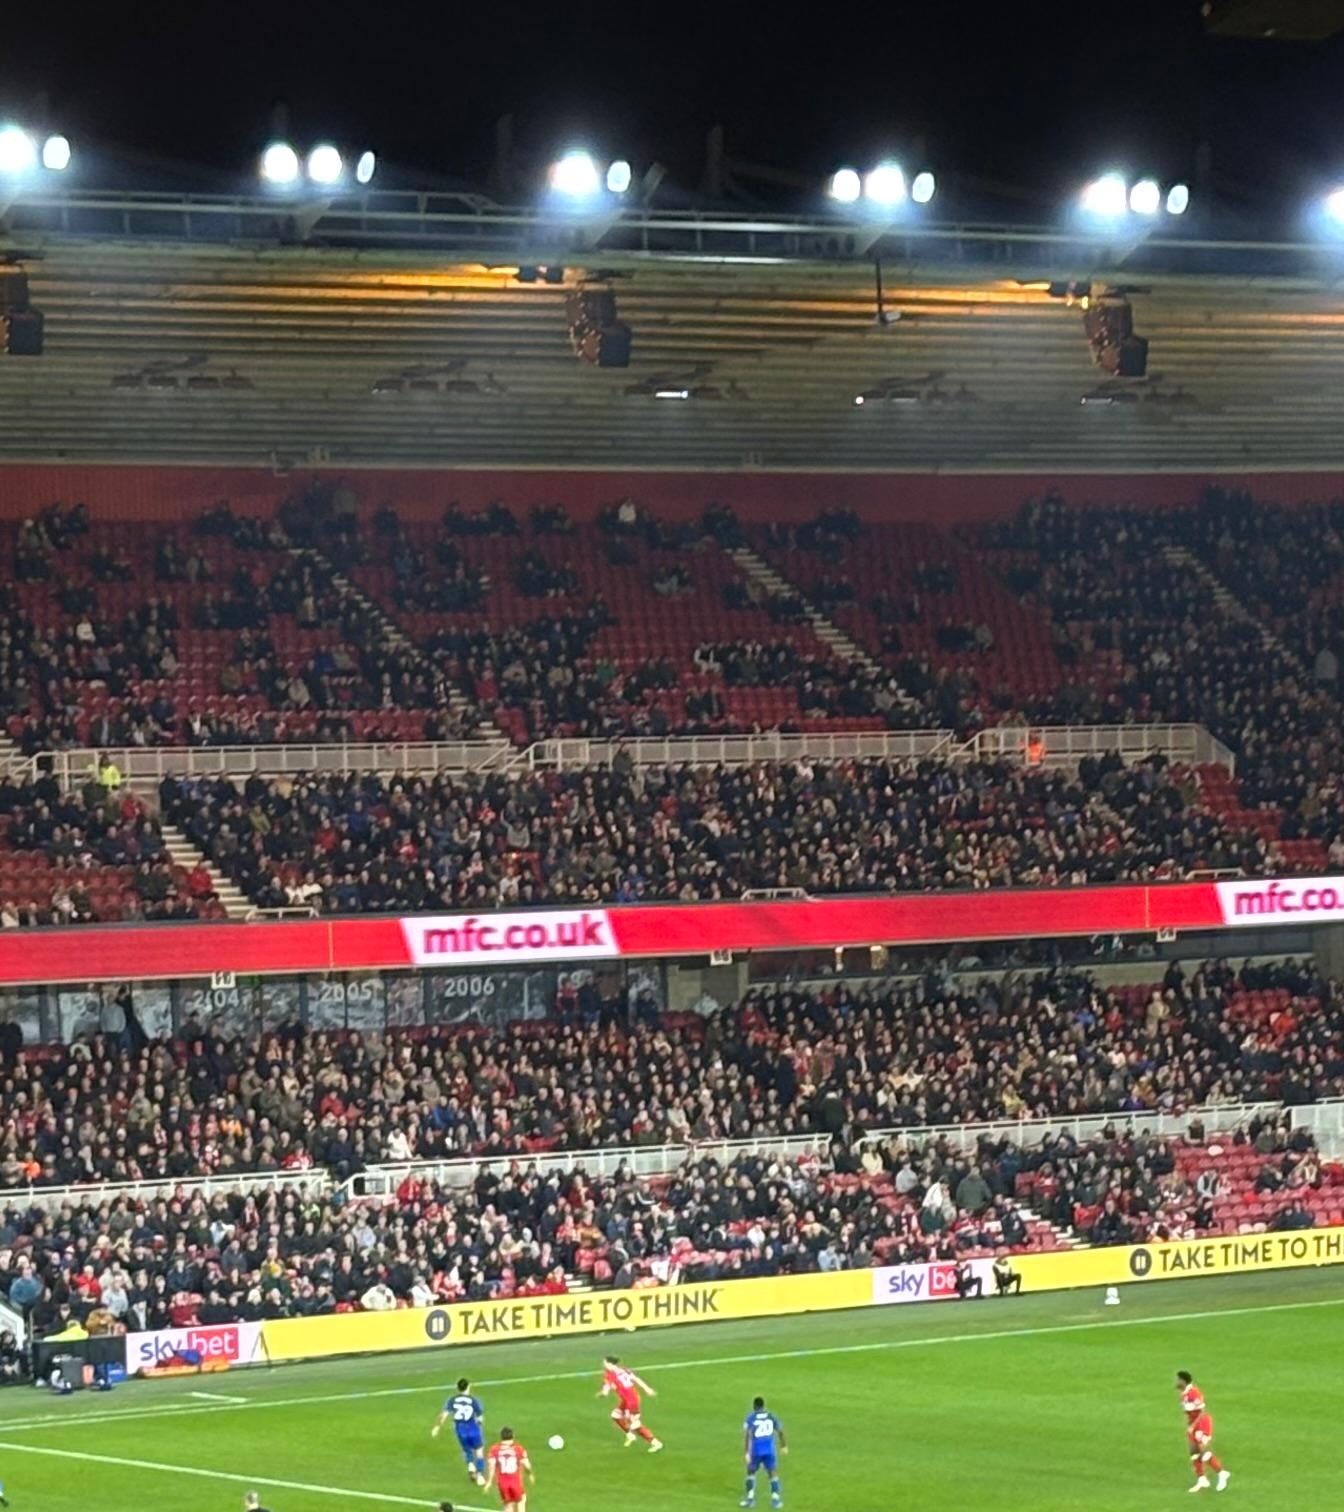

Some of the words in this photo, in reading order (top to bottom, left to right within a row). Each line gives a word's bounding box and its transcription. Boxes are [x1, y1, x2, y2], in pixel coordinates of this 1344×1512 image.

[423, 914, 607, 953] mfc.co.uk
[445, 976, 494, 997] 2006
[1159, 1245, 1215, 1272] TAKE
[1221, 1240, 1273, 1266] TIME
[1278, 1237, 1307, 1261] TO
[889, 1270, 925, 1297] sky
[459, 1306, 524, 1335] TAKE
[531, 1300, 592, 1329] TIME
[598, 1296, 633, 1322] TO
[639, 1289, 719, 1319] THINK
[192, 1330, 236, 1356] bet
[753, 1419, 774, 1438] 20
